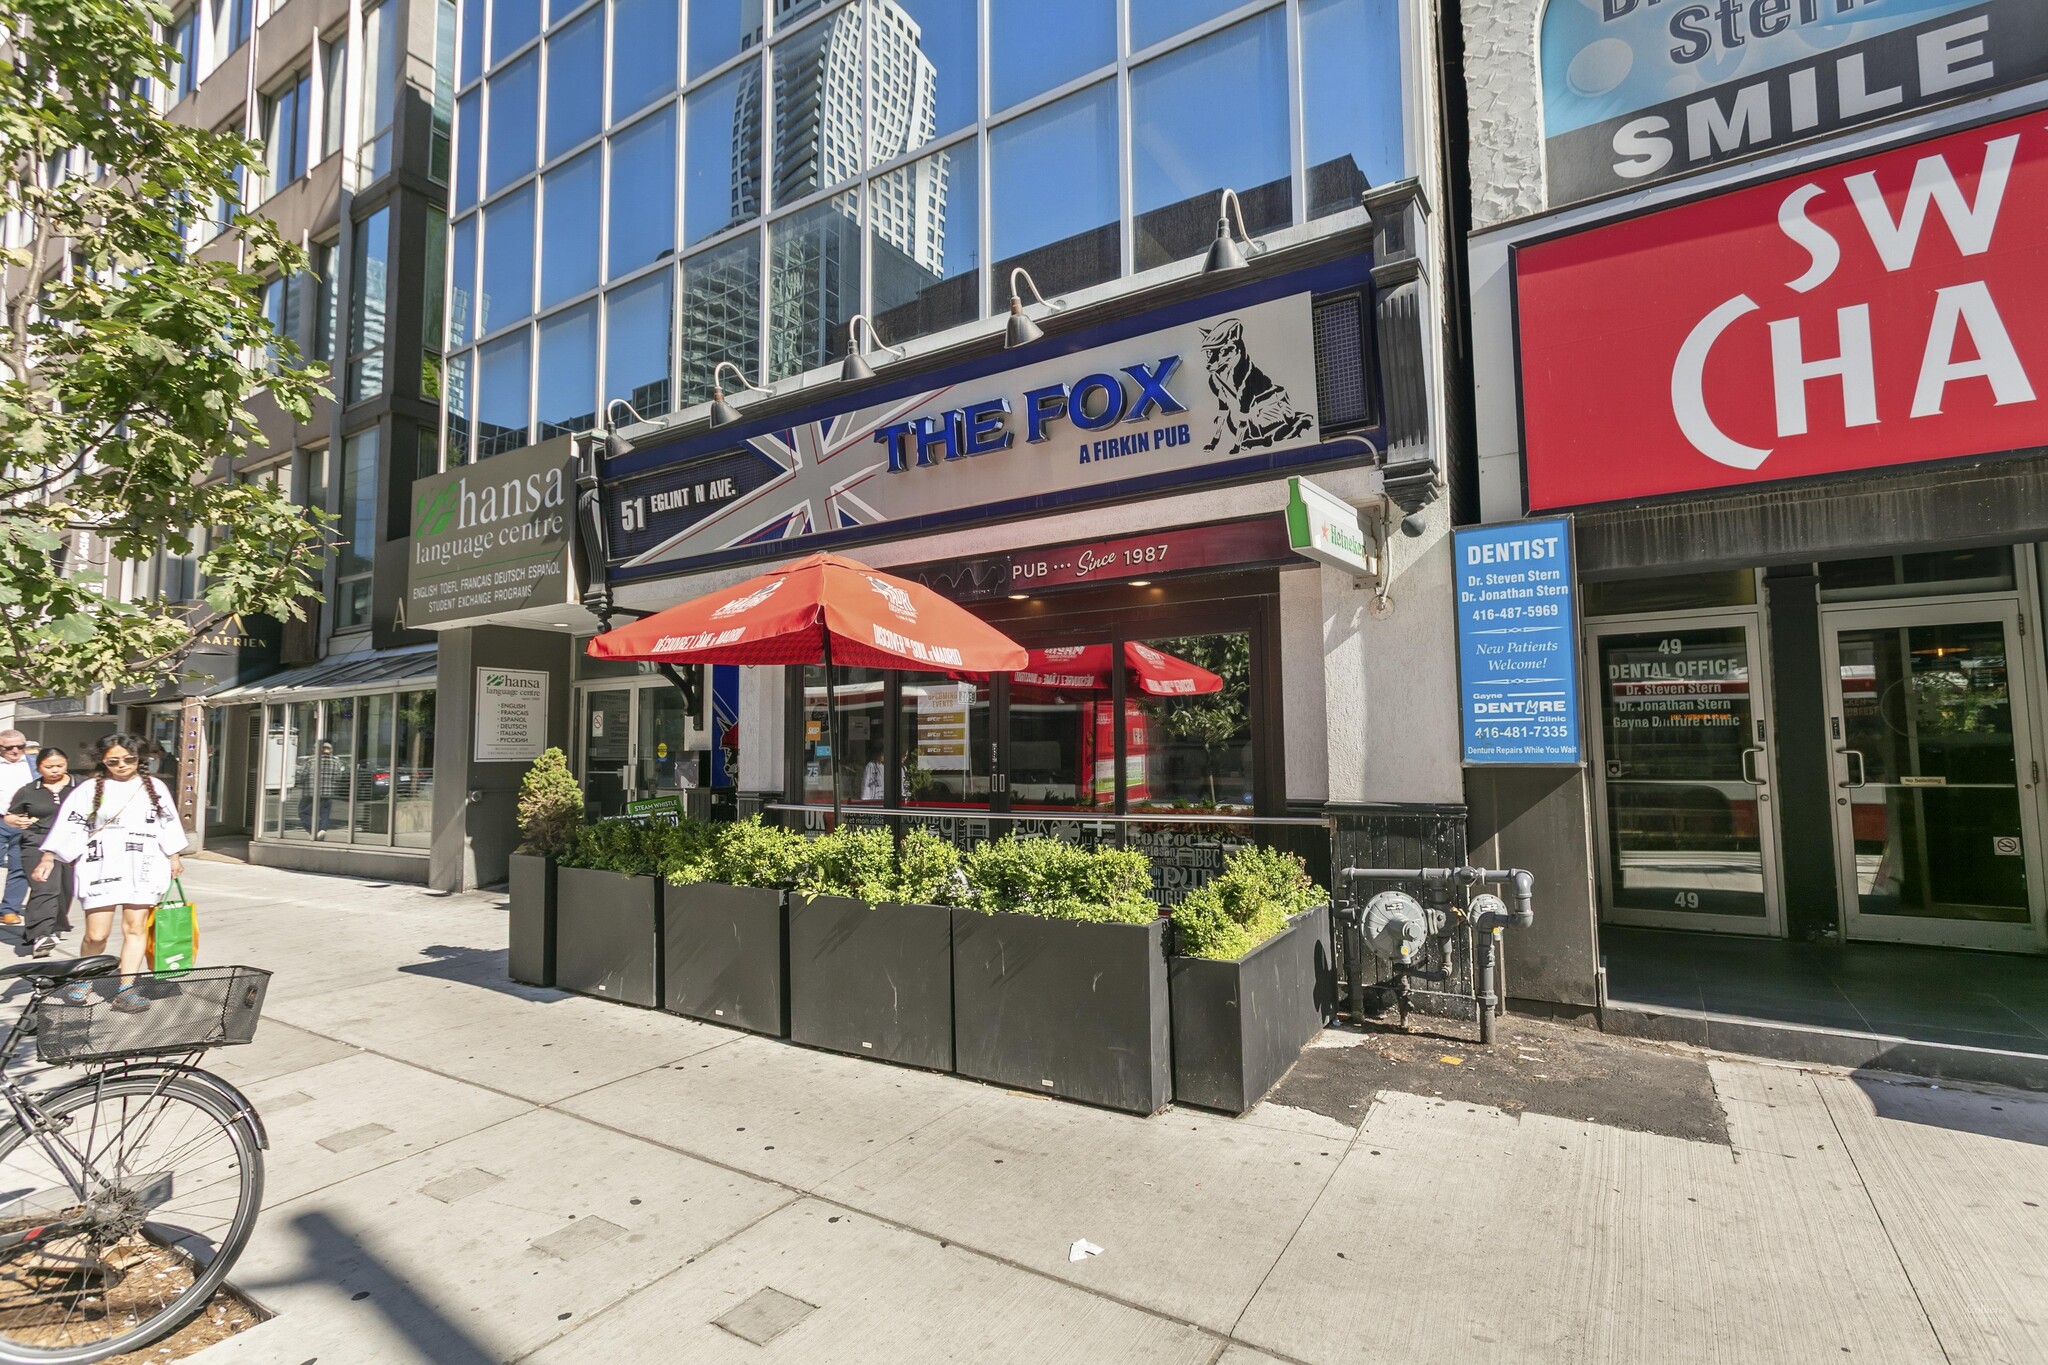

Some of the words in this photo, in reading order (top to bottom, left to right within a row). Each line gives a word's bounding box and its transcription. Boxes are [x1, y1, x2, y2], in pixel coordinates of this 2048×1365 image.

[1669, 0, 1883, 65] Ste
[1612, 14, 1995, 178] SMILE
[1776, 126, 2048, 294] SW
[1671, 280, 2037, 471] CHA
[873, 397, 1013, 474] THE
[1023, 354, 1190, 444] FOX
[1079, 444, 1091, 464] A
[1093, 431, 1150, 461] FIRKIN
[1154, 423, 1191, 451] PUB
[457, 467, 565, 530] hansa
[621, 497, 645, 531] 51
[650, 487, 690, 513] EGLINT
[695, 484, 705, 503] N
[709, 478, 737, 500] AVE.
[416, 531, 494, 566] language
[499, 515, 563, 547] centre
[1467, 537, 1558, 565] DENTIST
[1012, 561, 1048, 580] PUB
[1076, 550, 1117, 577] Since
[1123, 544, 1169, 565] 1987
[413, 584, 438, 600] ENGLISH
[440, 581, 459, 595] TOEFL
[460, 574, 492, 593] FRANÇAIS
[494, 567, 526, 584] DEUTSCH
[528, 560, 561, 579] ESPAÑOL
[1468, 575, 1483, 587] Dr.
[1486, 572, 1525, 585] Steven
[1528, 570, 1560, 581] Stern
[428, 597, 456, 613] STUDENT
[458, 591, 492, 608] EXCHANGE
[494, 584, 533, 601] PROGRAMS
[1461, 591, 1476, 603] Dr.
[1479, 587, 1533, 602] Jonathan
[1536, 584, 1569, 597] Stern
[1472, 604, 1559, 621] 416-487-5969
[873, 624, 906, 654] DISCOVER
[910, 639, 931, 661] SOUL
[931, 645, 963, 665] MADRID
[1476, 643, 1504, 655] New
[1507, 641, 1558, 653] Patients
[1658, 638, 1682, 655] 49
[1488, 657, 1547, 671] Welcome!
[1609, 662, 1671, 679] DENTAL
[1675, 659, 1738, 677] OFFICE
[505, 675, 540, 689] hansa
[1626, 685, 1641, 696] Dr.
[1644, 684, 1685, 695] Steven
[1688, 683, 1721, 694] Stern
[486, 687, 518, 697] language
[927, 691, 957, 701] UPCOMING
[932, 700, 953, 708] EVENTS
[1473, 700, 1567, 715] DENTURE
[1619, 701, 1634, 712] Dr.
[1637, 699, 1694, 712] Jonathan
[1697, 699, 1731, 710] Stern
[1475, 725, 1568, 738] 416-481-7335
[1468, 746, 1495, 754] Denture
[1496, 746, 1523, 755] Repairs
[1560, 745, 1577, 753] Wait
[807, 767, 818, 777] 75
[634, 804, 654, 812] STEAM
[653, 800, 678, 809] WHISTLE
[805, 811, 826, 830] UK
[1026, 819, 1048, 834] UK
[1195, 848, 1221, 868] BBC
[1674, 892, 1699, 909] 49
